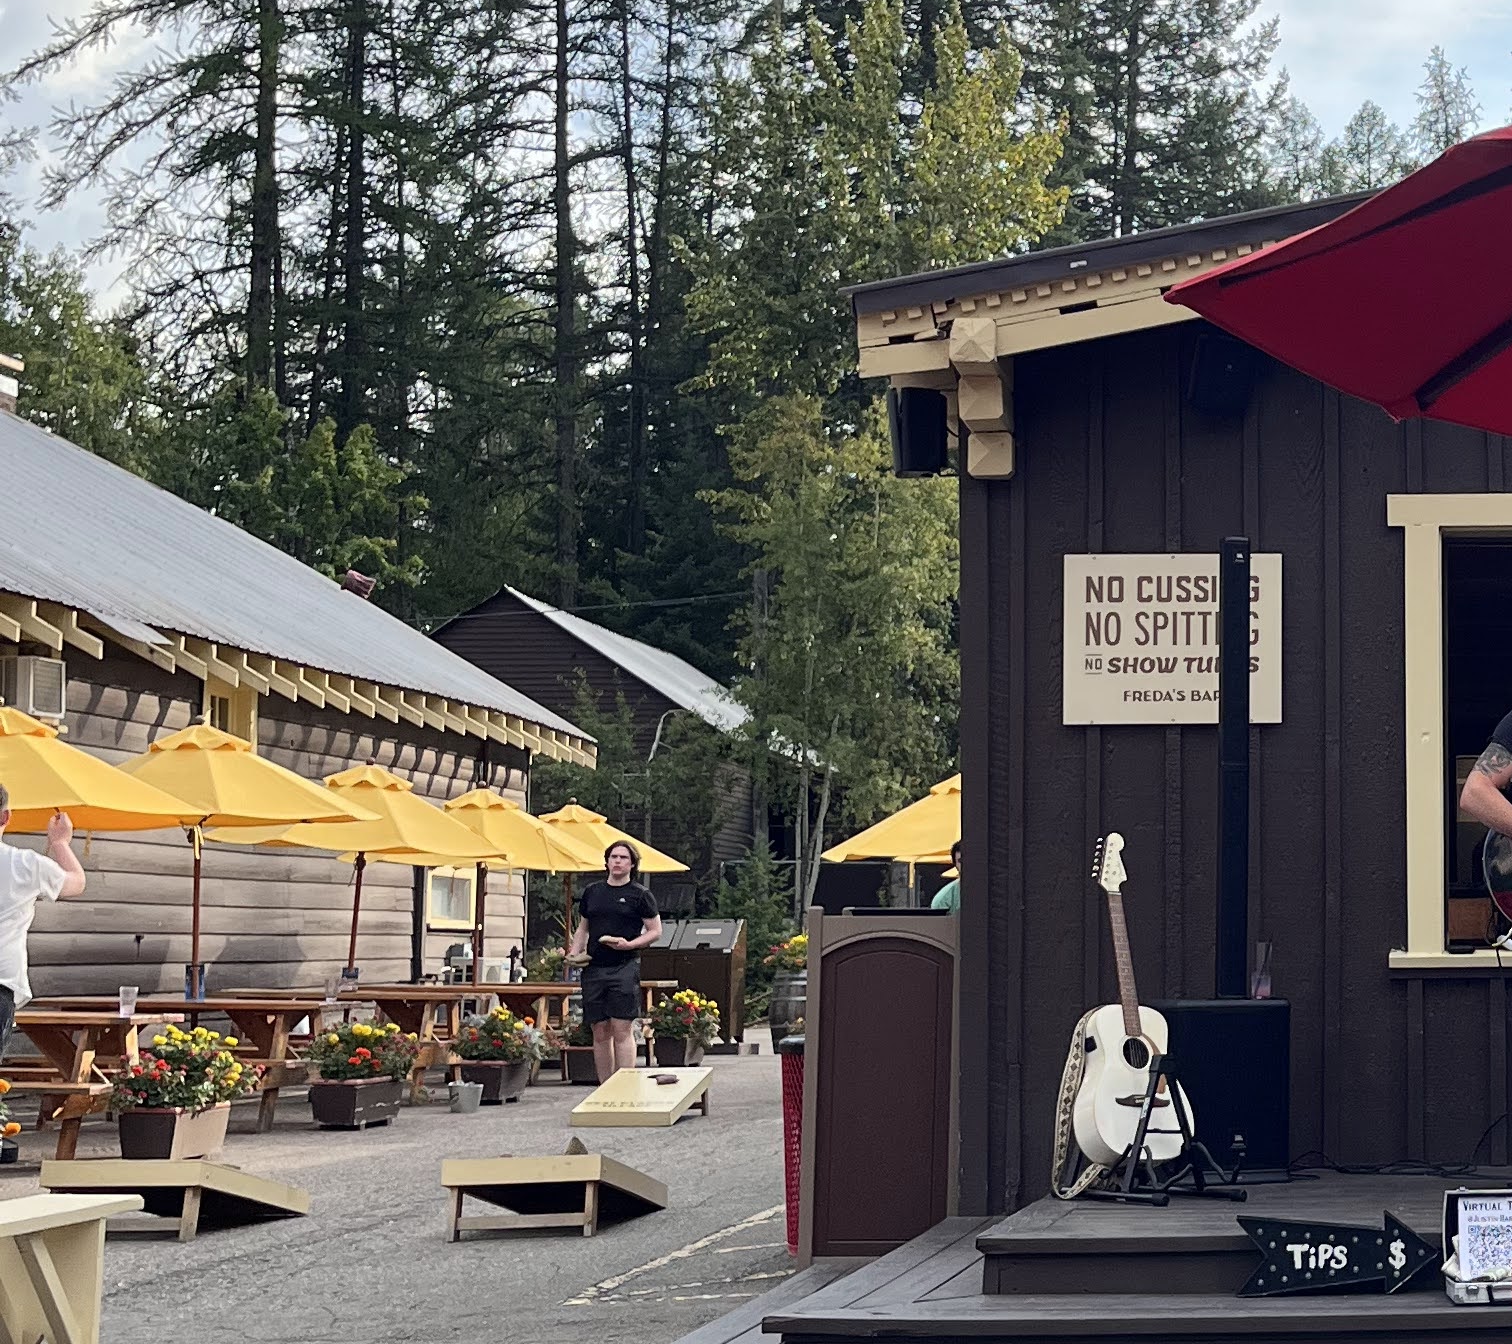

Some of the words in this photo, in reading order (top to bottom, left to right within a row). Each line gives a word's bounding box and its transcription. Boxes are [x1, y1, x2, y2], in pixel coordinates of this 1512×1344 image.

[1085, 576, 1124, 603] NO
[1137, 576, 1260, 603] CUSSIG
[1085, 611, 1121, 646] NO
[1134, 611, 1260, 646] SPITTIG
[1084, 658, 1102, 671] NO
[1107, 656, 1178, 674] SHOW
[1183, 656, 1260, 674] TUS
[1123, 689, 1186, 702] FREDA'S
[1463, 1200, 1502, 1211] VIRTUAL
[1388, 1239, 1406, 1270] $
